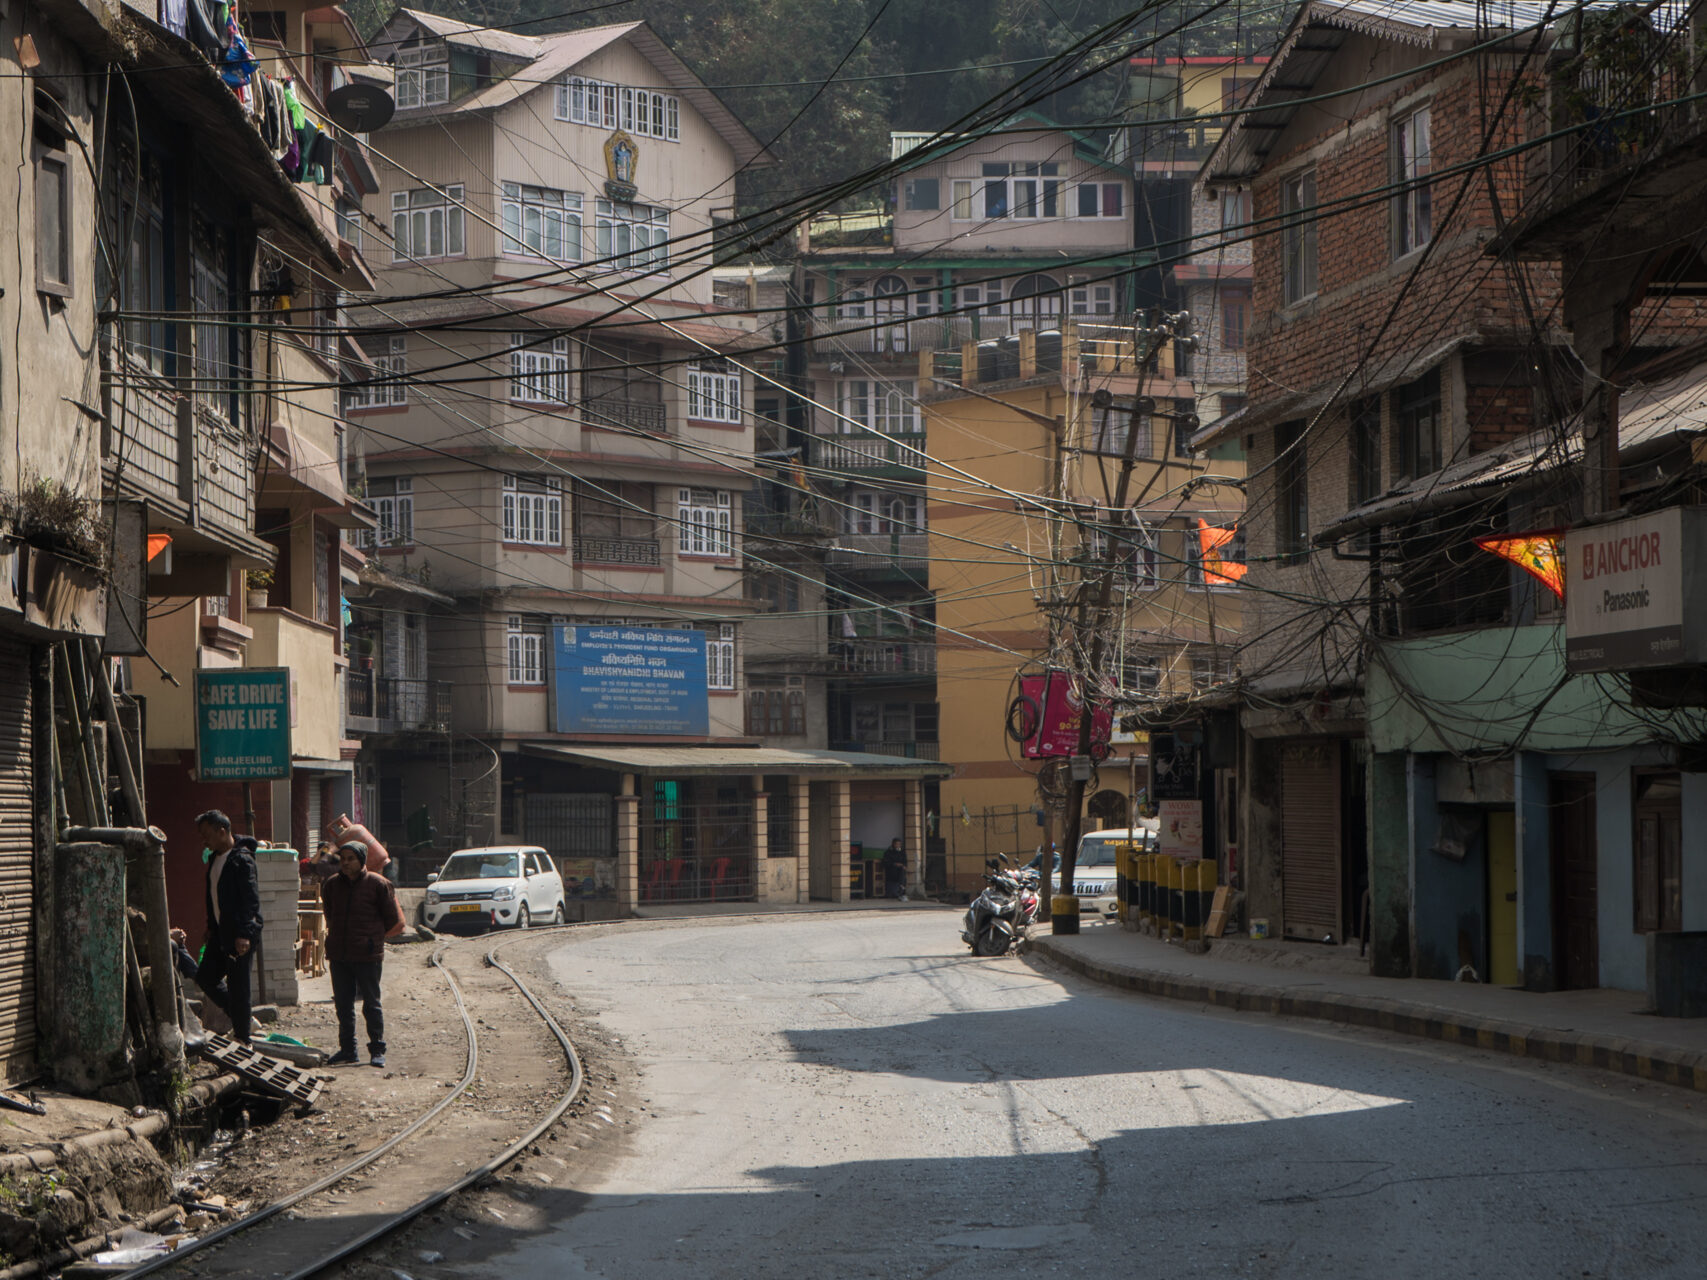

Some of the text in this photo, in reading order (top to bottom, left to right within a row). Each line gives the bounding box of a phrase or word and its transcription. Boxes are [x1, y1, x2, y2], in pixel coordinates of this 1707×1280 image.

[1597, 531, 1661, 576] ANCHOR
[1603, 584, 1650, 613] Panasonic
[583, 666, 685, 679] BHAVISHYANIDHI BHAVAN
[200, 683, 284, 705] SAFE DRIVE
[207, 709, 278, 730] SAVE LIFE
[214, 755, 273, 765] DARJEELING
[203, 766, 284, 776] DISTRICT POLICE
